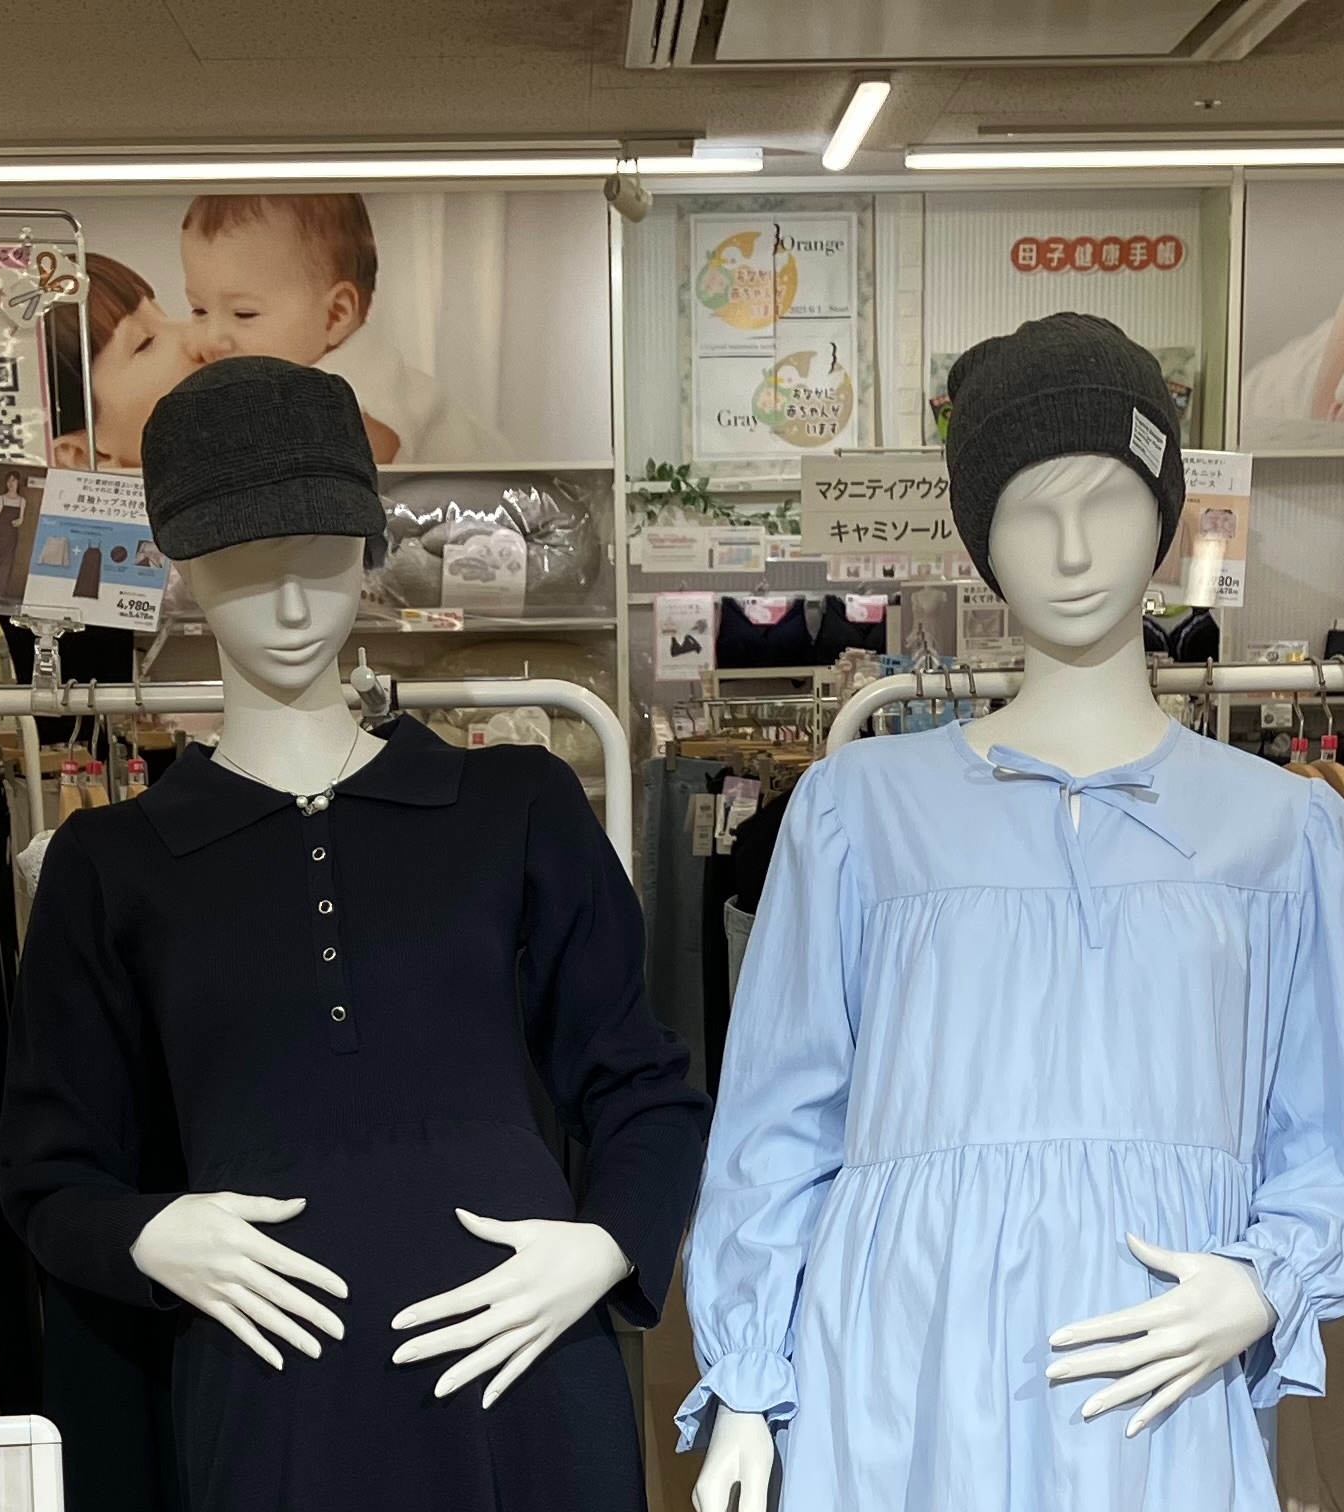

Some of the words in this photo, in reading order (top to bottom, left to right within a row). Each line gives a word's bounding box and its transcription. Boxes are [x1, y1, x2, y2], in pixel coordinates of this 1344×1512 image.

[781, 235, 845, 257] Orange
[1017, 240, 1177, 268] 母子健康手帳
[792, 387, 836, 400] おなかに
[717, 409, 758, 432] Gray
[829, 519, 953, 544] キャミソール
